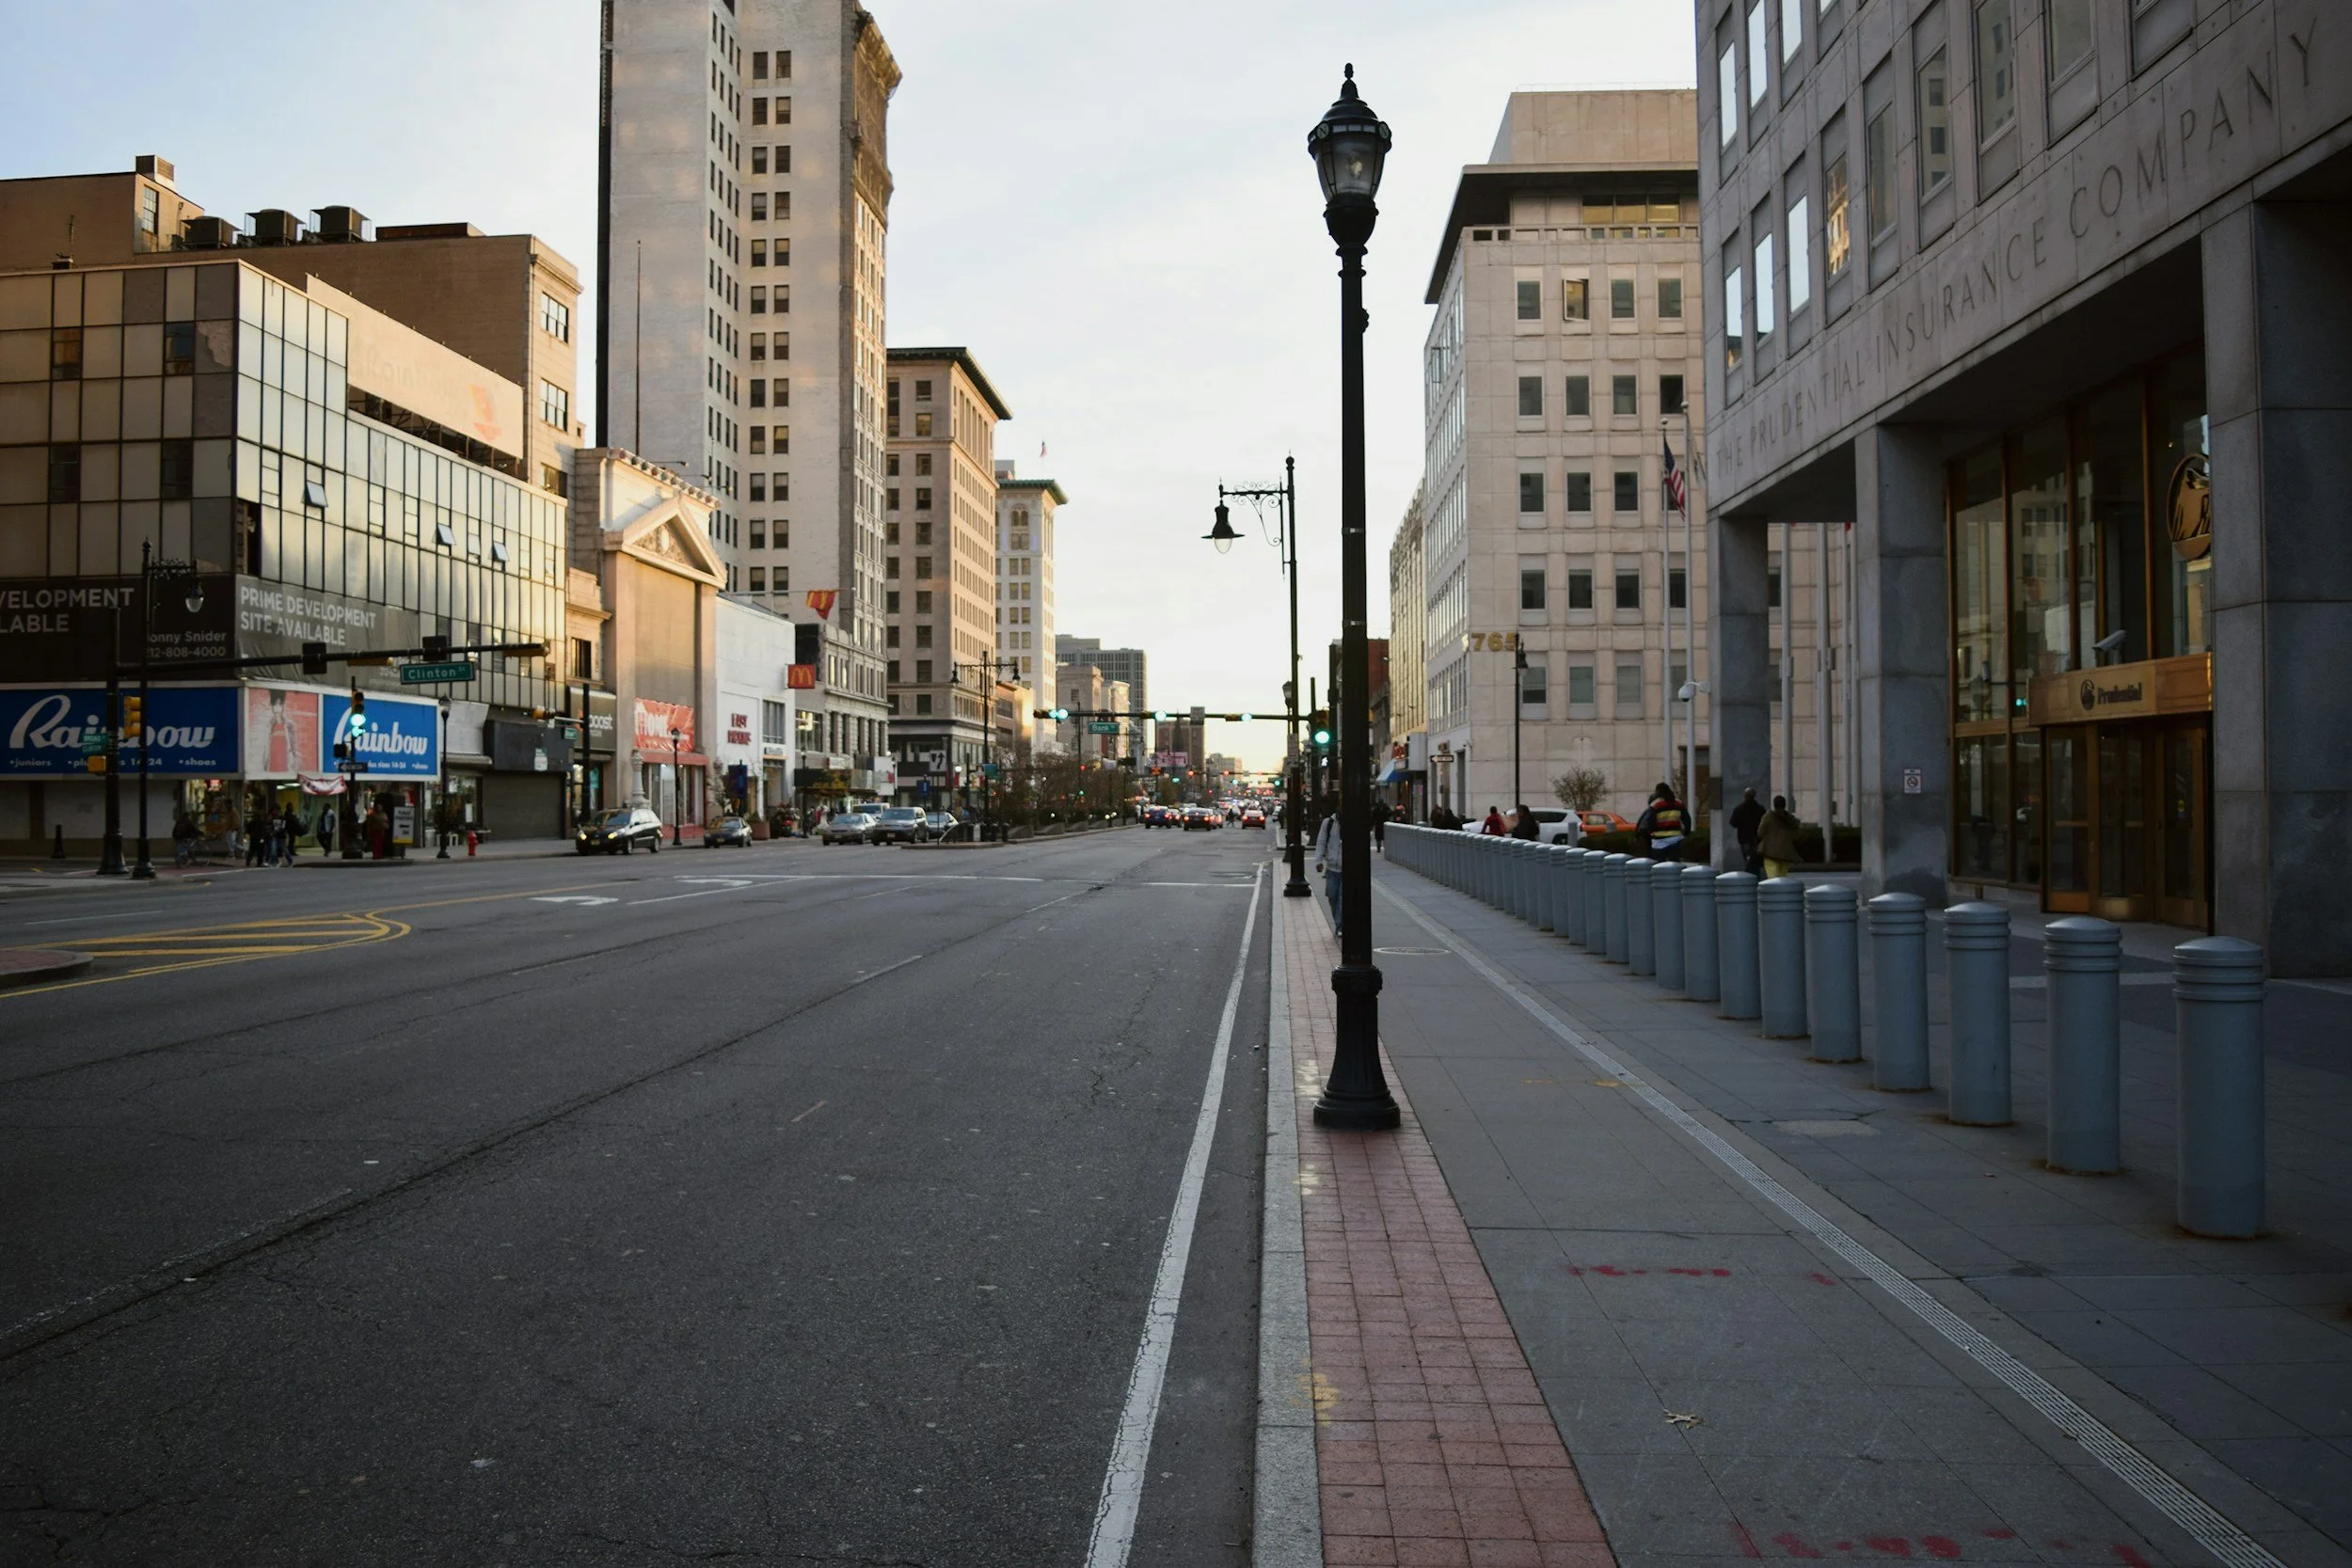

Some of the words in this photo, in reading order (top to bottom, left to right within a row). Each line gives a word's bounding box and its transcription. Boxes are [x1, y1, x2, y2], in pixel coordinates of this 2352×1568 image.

[1716, 436, 1743, 478] THE
[1750, 349, 1866, 458] PRUDENTIAL
[1876, 216, 2047, 373] INSURANCE
[2070, 16, 2317, 239] COMPANY
[241, 586, 283, 612] PRIME
[286, 595, 377, 629] DEVELOPMENT
[184, 631, 227, 642] Snider
[241, 611, 273, 633] SITE
[276, 619, 346, 645] AVAILABLE
[407, 667, 456, 679] Clinton
